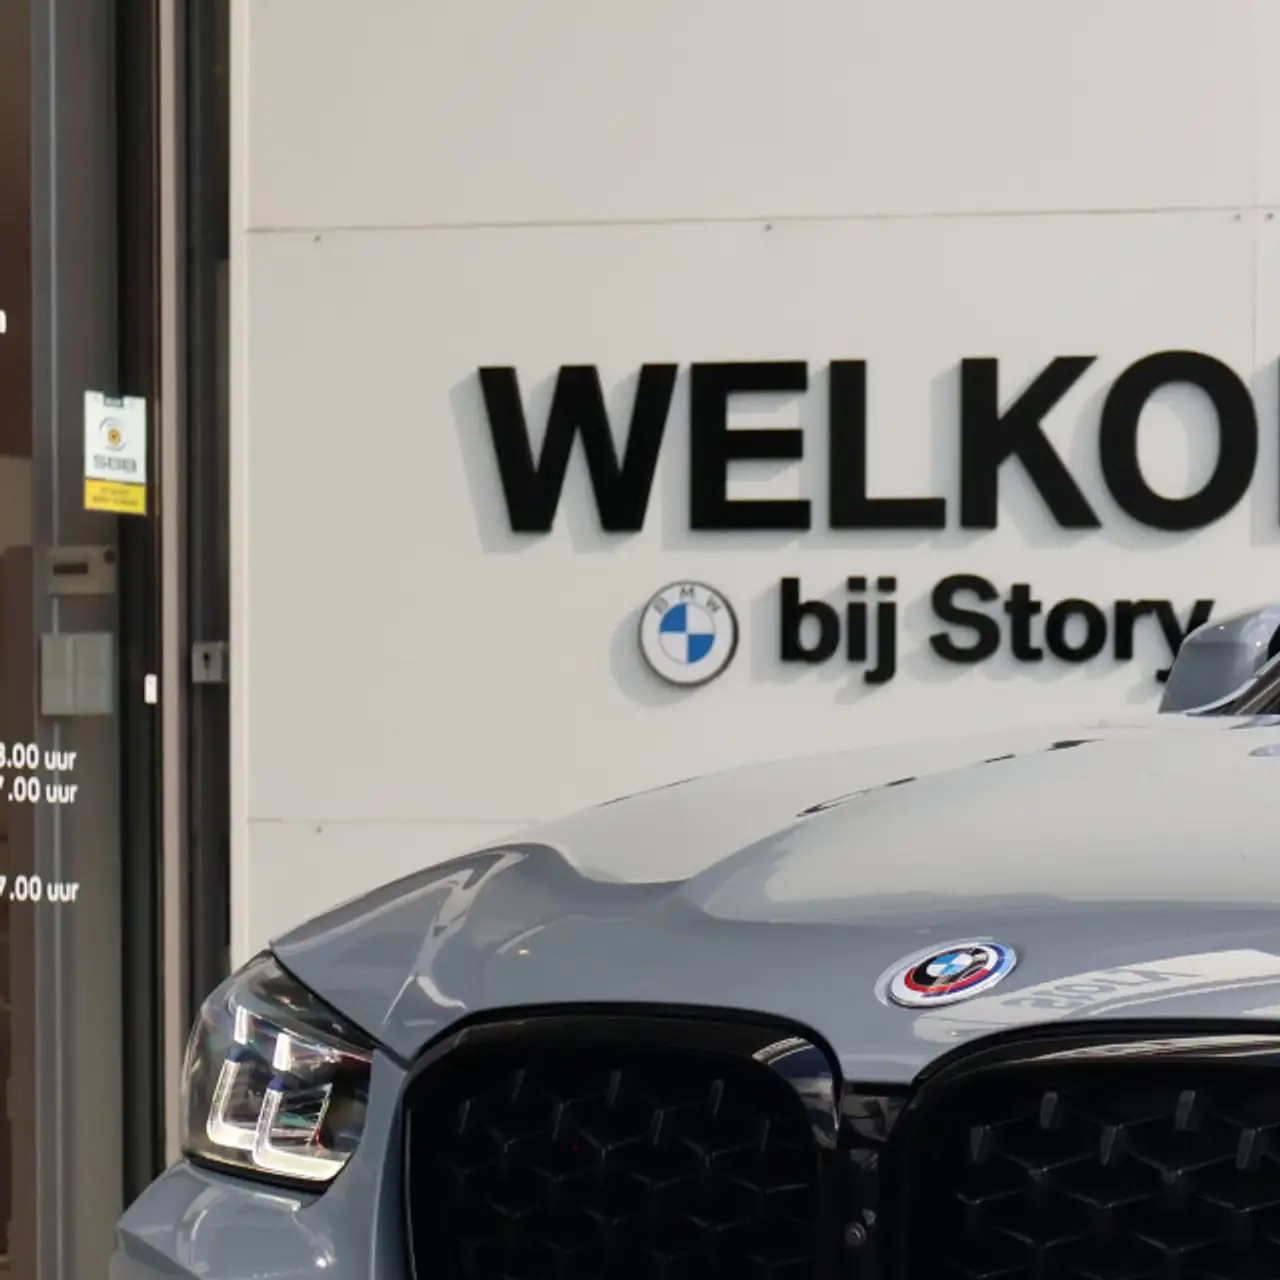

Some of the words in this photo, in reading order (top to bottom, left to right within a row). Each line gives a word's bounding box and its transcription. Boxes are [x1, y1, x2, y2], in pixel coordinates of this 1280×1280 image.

[780, 576, 896, 685] bij
[929, 574, 1215, 685] Story
[44, 751, 77, 771] uur
[45, 784, 78, 803] uur
[46, 882, 79, 902] uur
